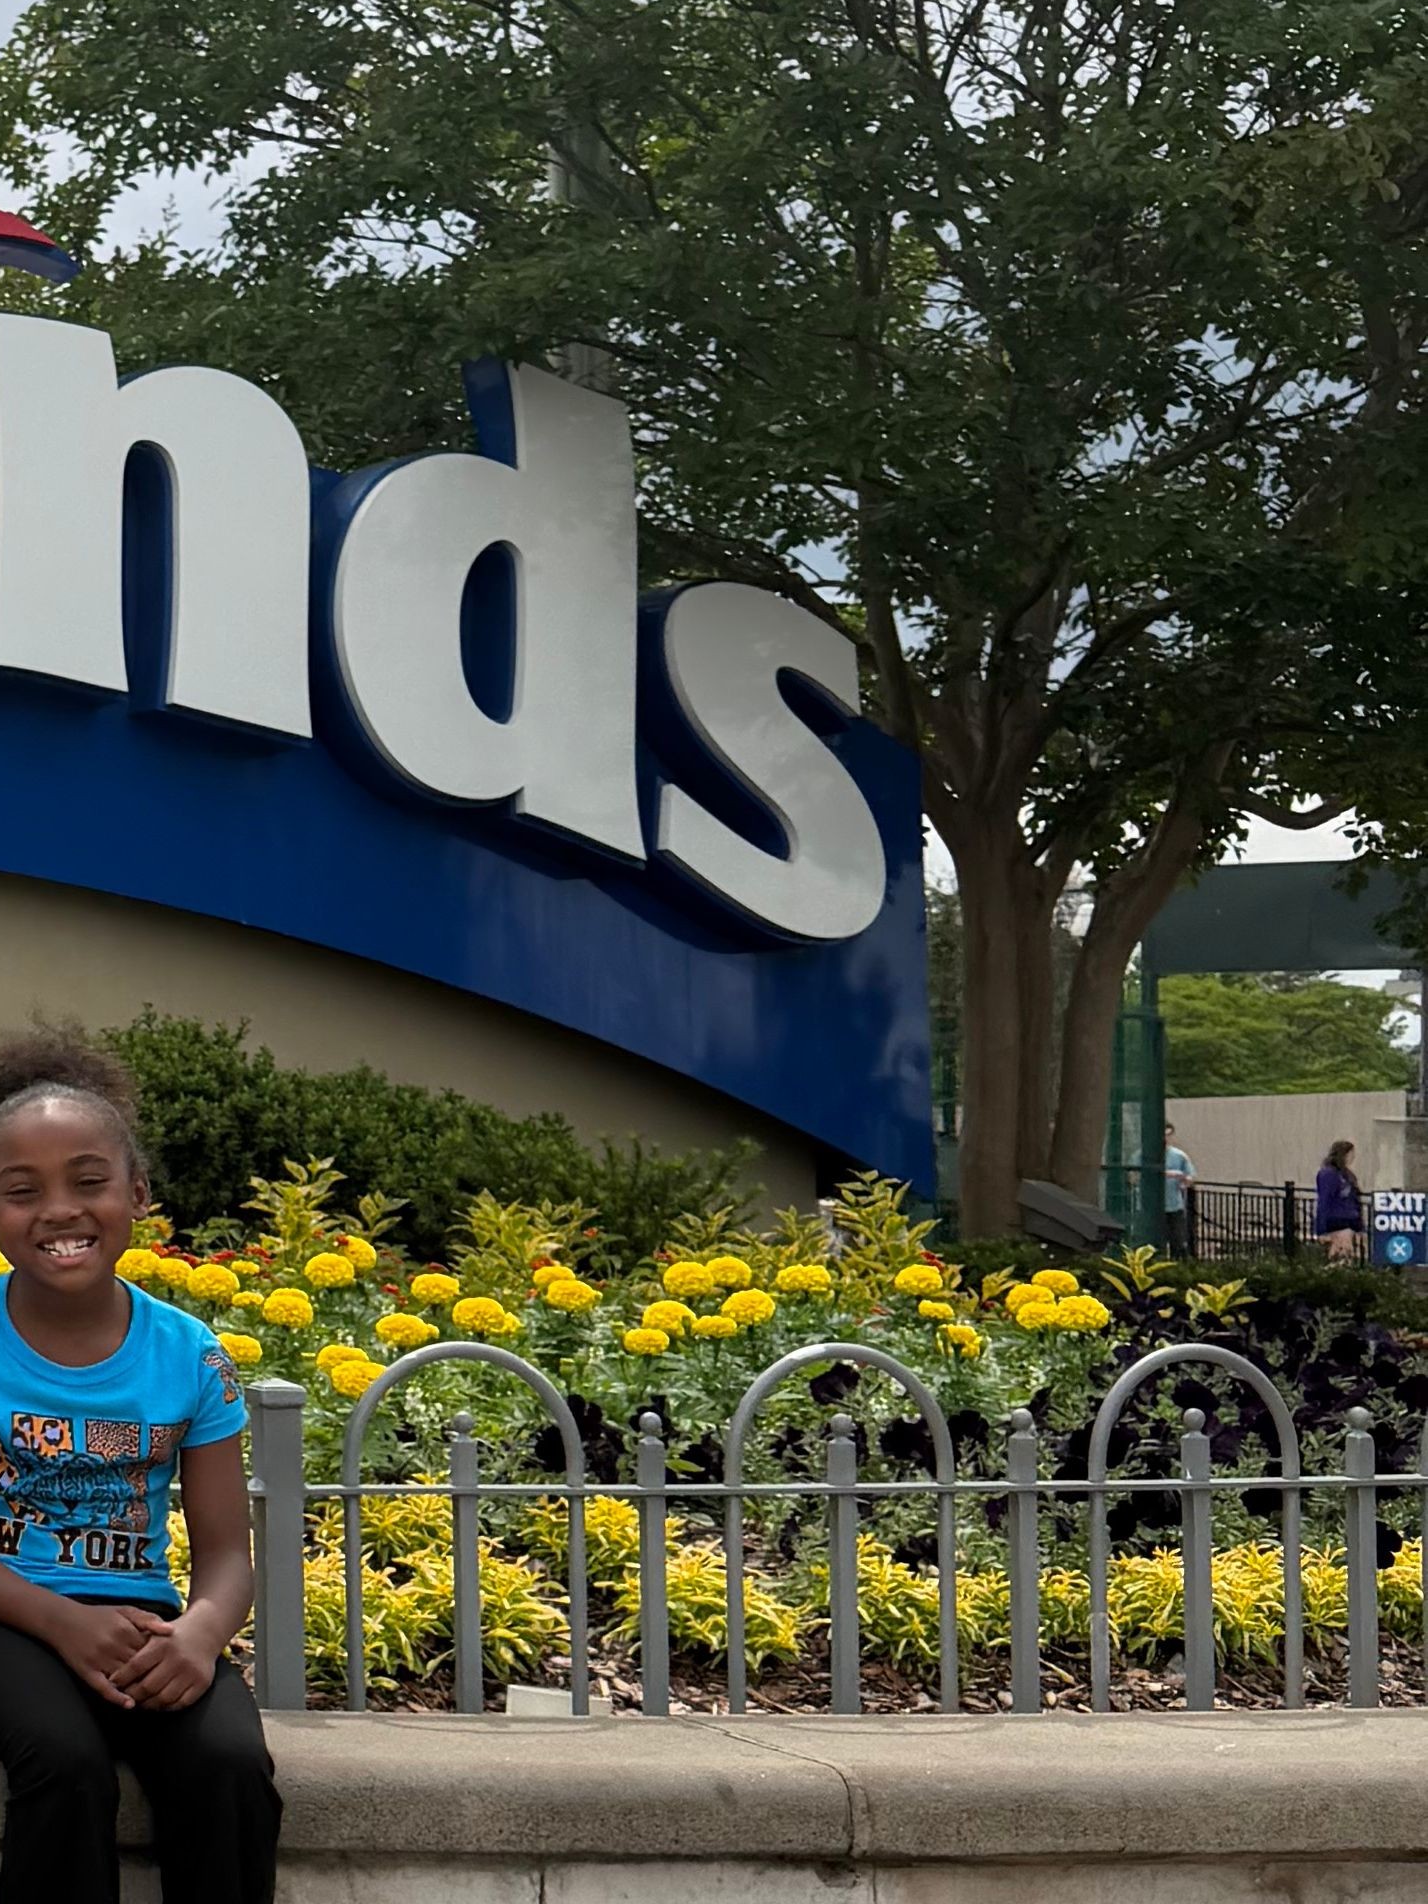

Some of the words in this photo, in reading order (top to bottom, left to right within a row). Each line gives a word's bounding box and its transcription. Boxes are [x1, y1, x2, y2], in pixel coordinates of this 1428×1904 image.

[1373, 1192, 1426, 1213] EXIT
[1374, 1214, 1426, 1232] ONLY
[51, 1528, 155, 1571] YORK
